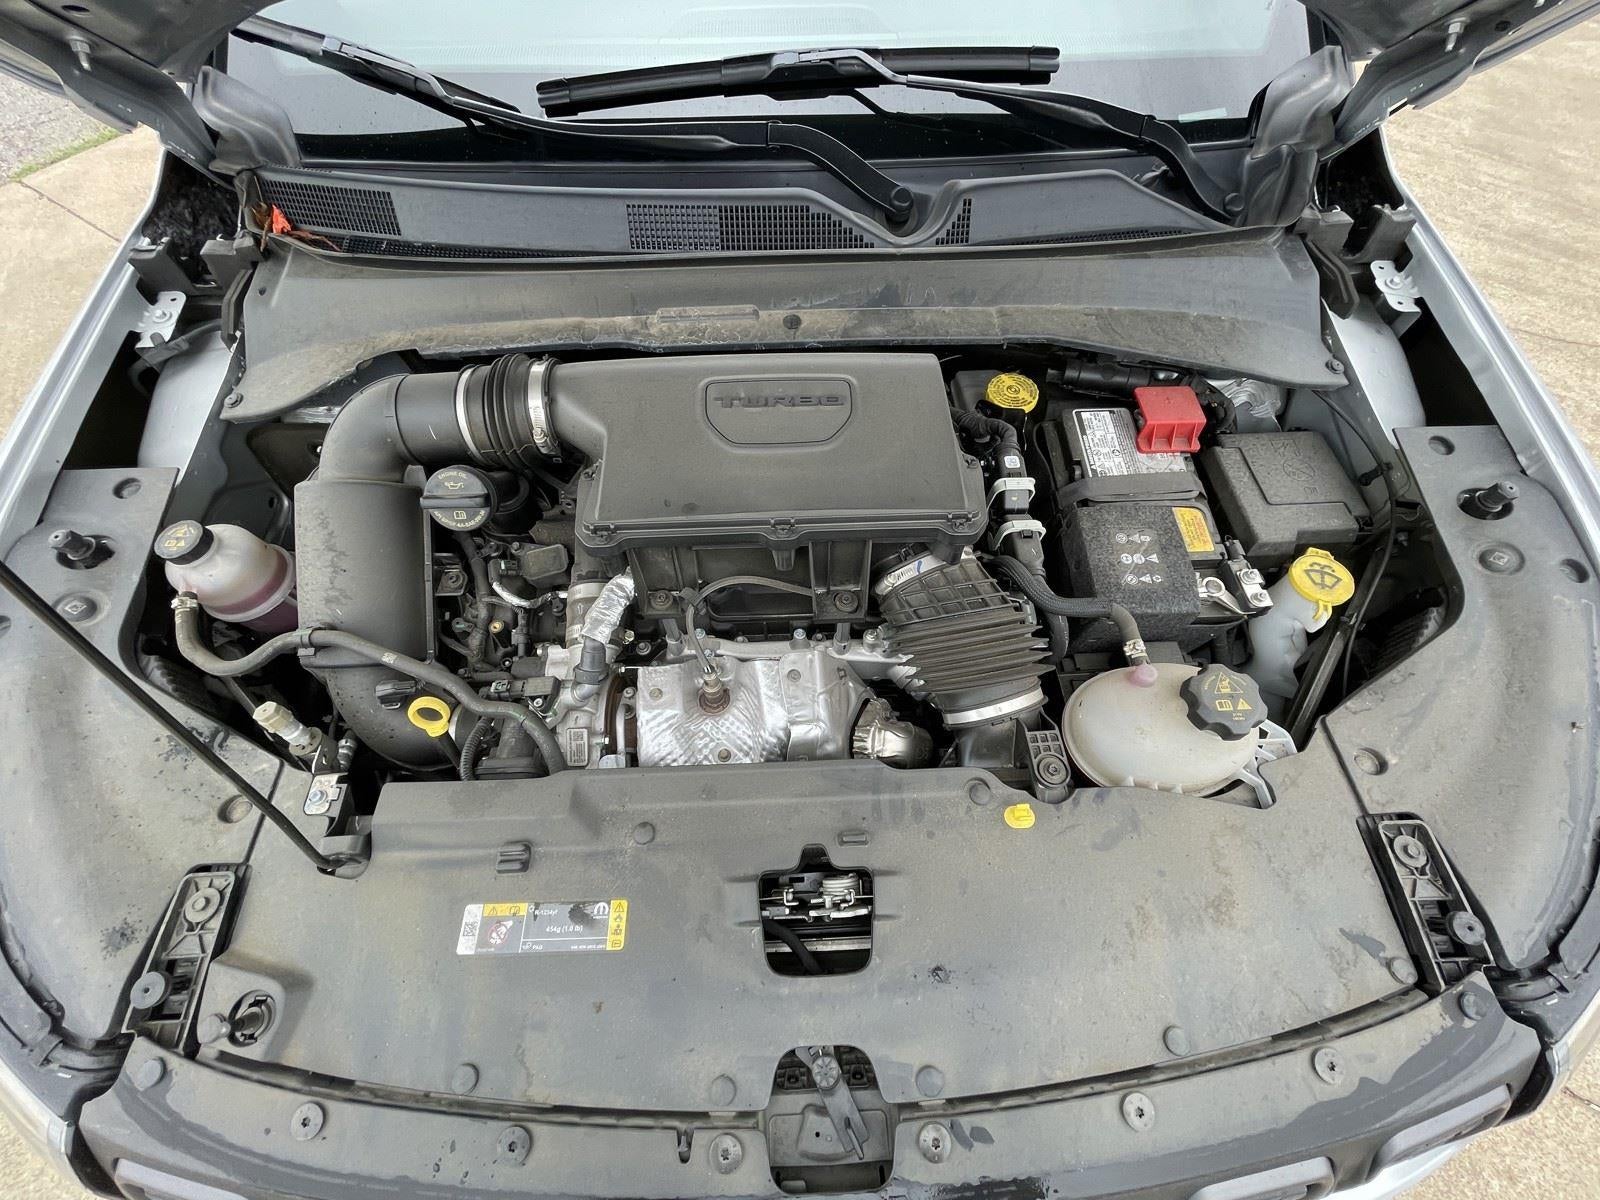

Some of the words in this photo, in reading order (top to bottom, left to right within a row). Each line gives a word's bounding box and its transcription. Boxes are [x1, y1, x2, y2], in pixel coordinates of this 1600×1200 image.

[713, 395, 848, 408] TURBO
[438, 471, 457, 479] ENGINE
[546, 925, 561, 934] 454g
[561, 925, 574, 934] (1.0
[575, 924, 583, 933] lb)
